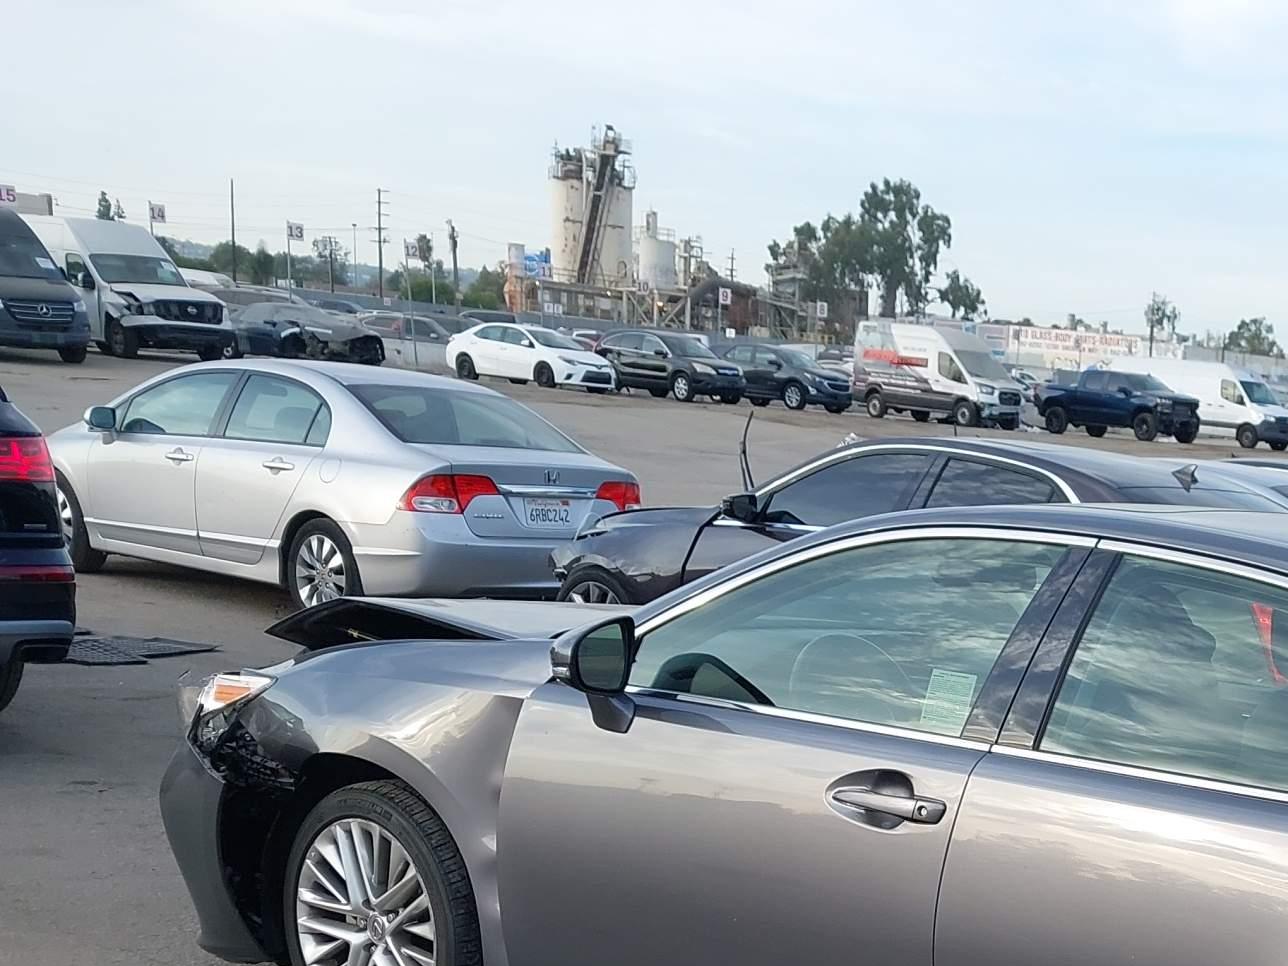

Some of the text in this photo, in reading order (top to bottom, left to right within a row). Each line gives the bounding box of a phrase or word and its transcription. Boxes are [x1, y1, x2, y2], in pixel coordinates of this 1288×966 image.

[150, 206, 166, 221] 14
[287, 225, 304, 239] 13
[405, 244, 418, 258] 12
[637, 281, 649, 293] 10
[530, 507, 571, 526] 6RBC242
